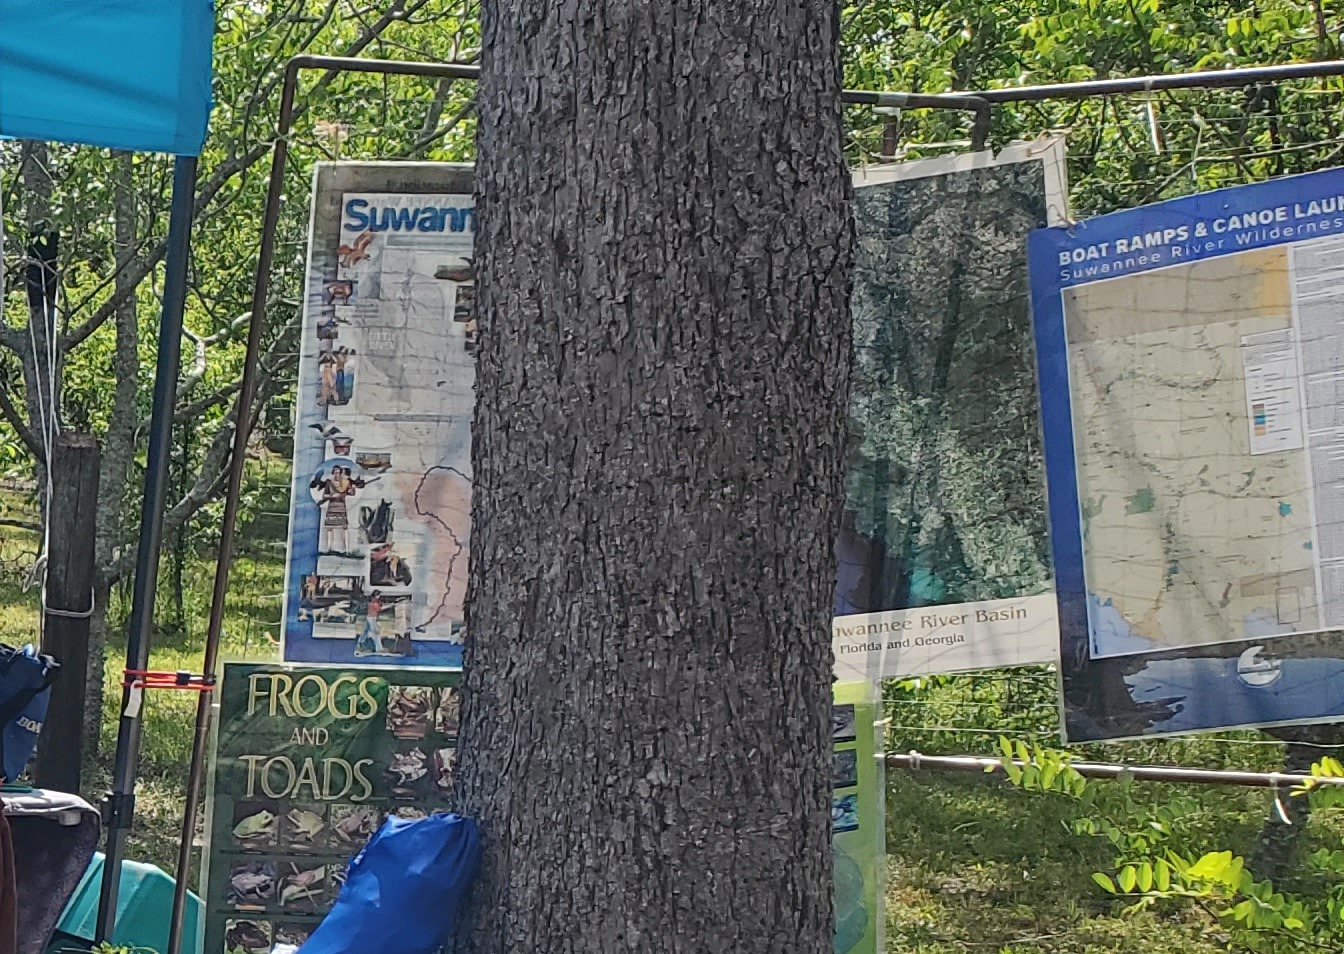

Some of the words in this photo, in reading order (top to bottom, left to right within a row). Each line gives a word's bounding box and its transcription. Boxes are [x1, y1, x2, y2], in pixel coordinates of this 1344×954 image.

[1058, 242, 1110, 266] BOAT
[1115, 225, 1189, 255] RAMPS
[1194, 221, 1209, 238] &
[1213, 206, 1289, 234] CANOE
[1059, 252, 1161, 282] Suwannee
[1171, 237, 1226, 259] River
[920, 613, 969, 630] River
[975, 606, 1028, 624] Basin
[839, 640, 883, 655] Florida
[886, 637, 911, 651] and
[915, 633, 965, 649] Georgia
[247, 673, 381, 720] FROGS
[290, 727, 329, 746] AND
[238, 754, 375, 801] TOADS
